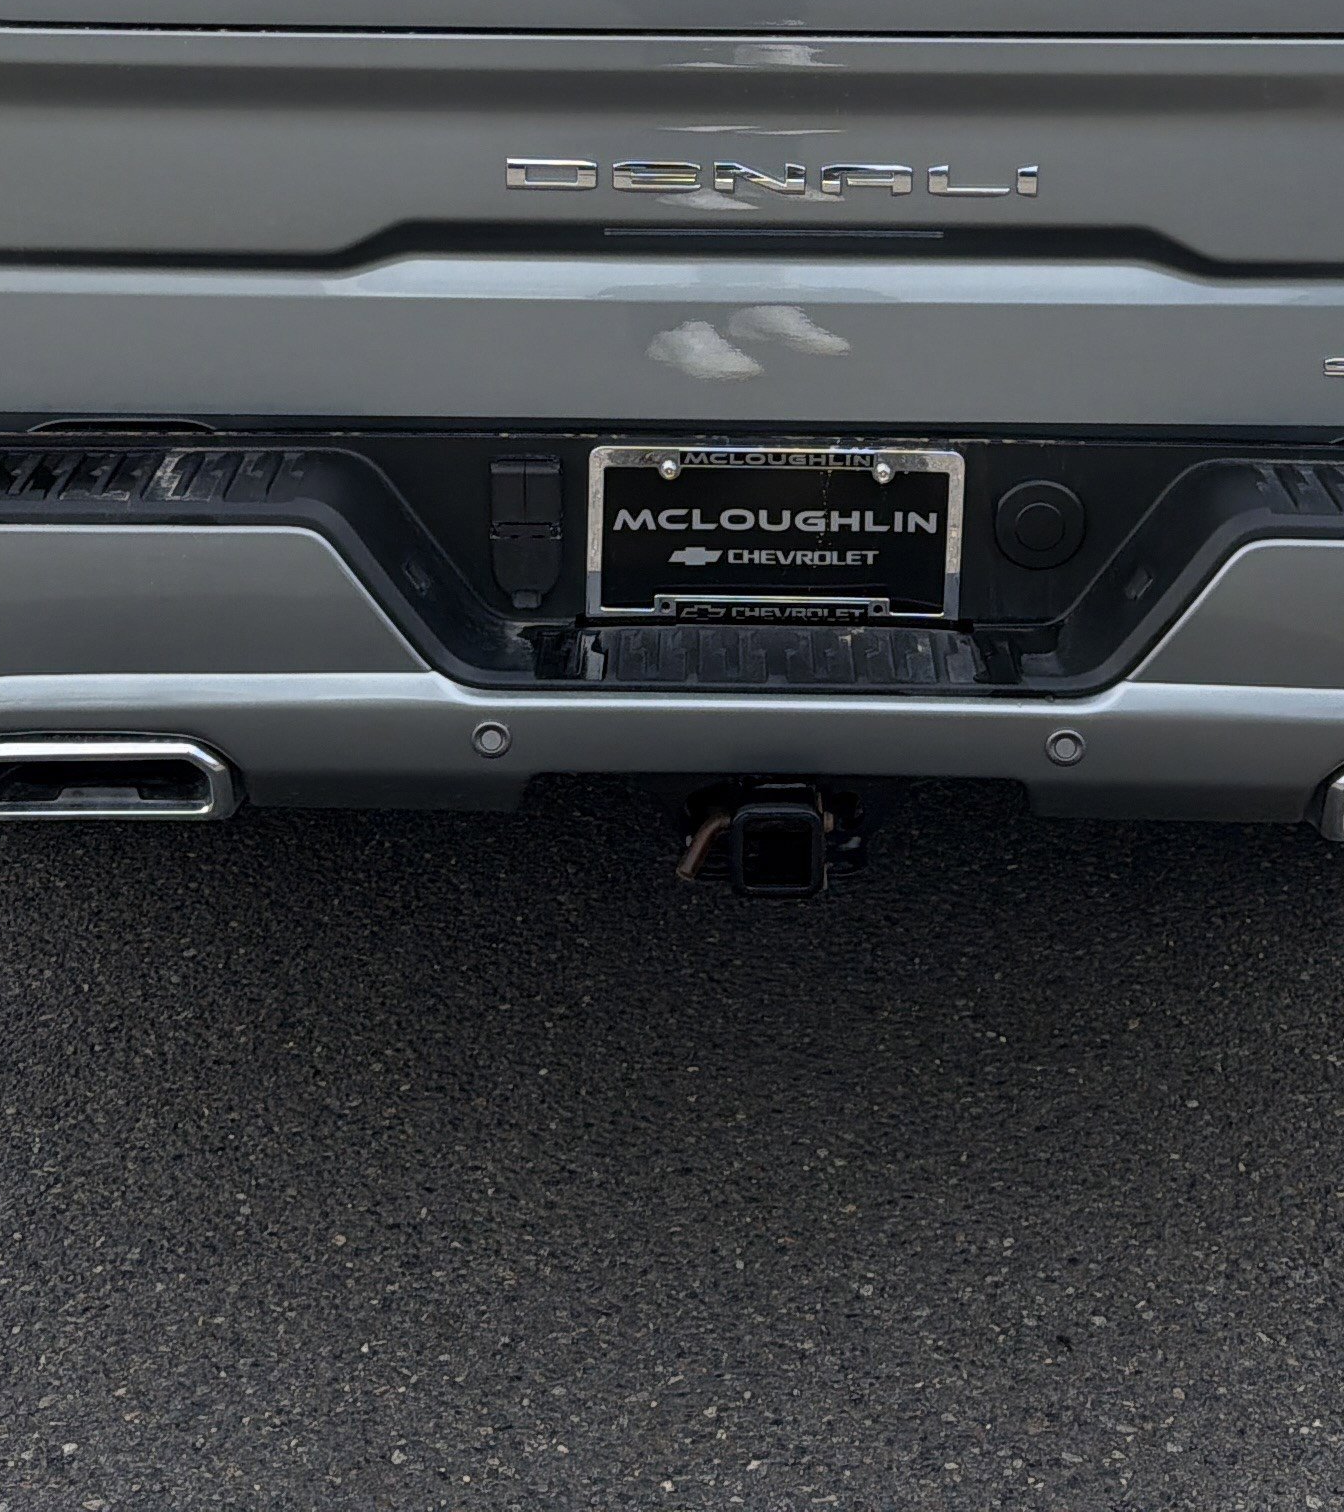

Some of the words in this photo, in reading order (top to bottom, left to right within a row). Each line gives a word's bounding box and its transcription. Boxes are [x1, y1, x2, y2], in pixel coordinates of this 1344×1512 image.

[505, 157, 1039, 196] DENALI
[684, 451, 872, 468] MCLOUGHLIN
[612, 508, 938, 534] MCLOUGHLIN
[727, 548, 879, 566] CHEVROLET
[731, 606, 865, 622] CHEVROLET
